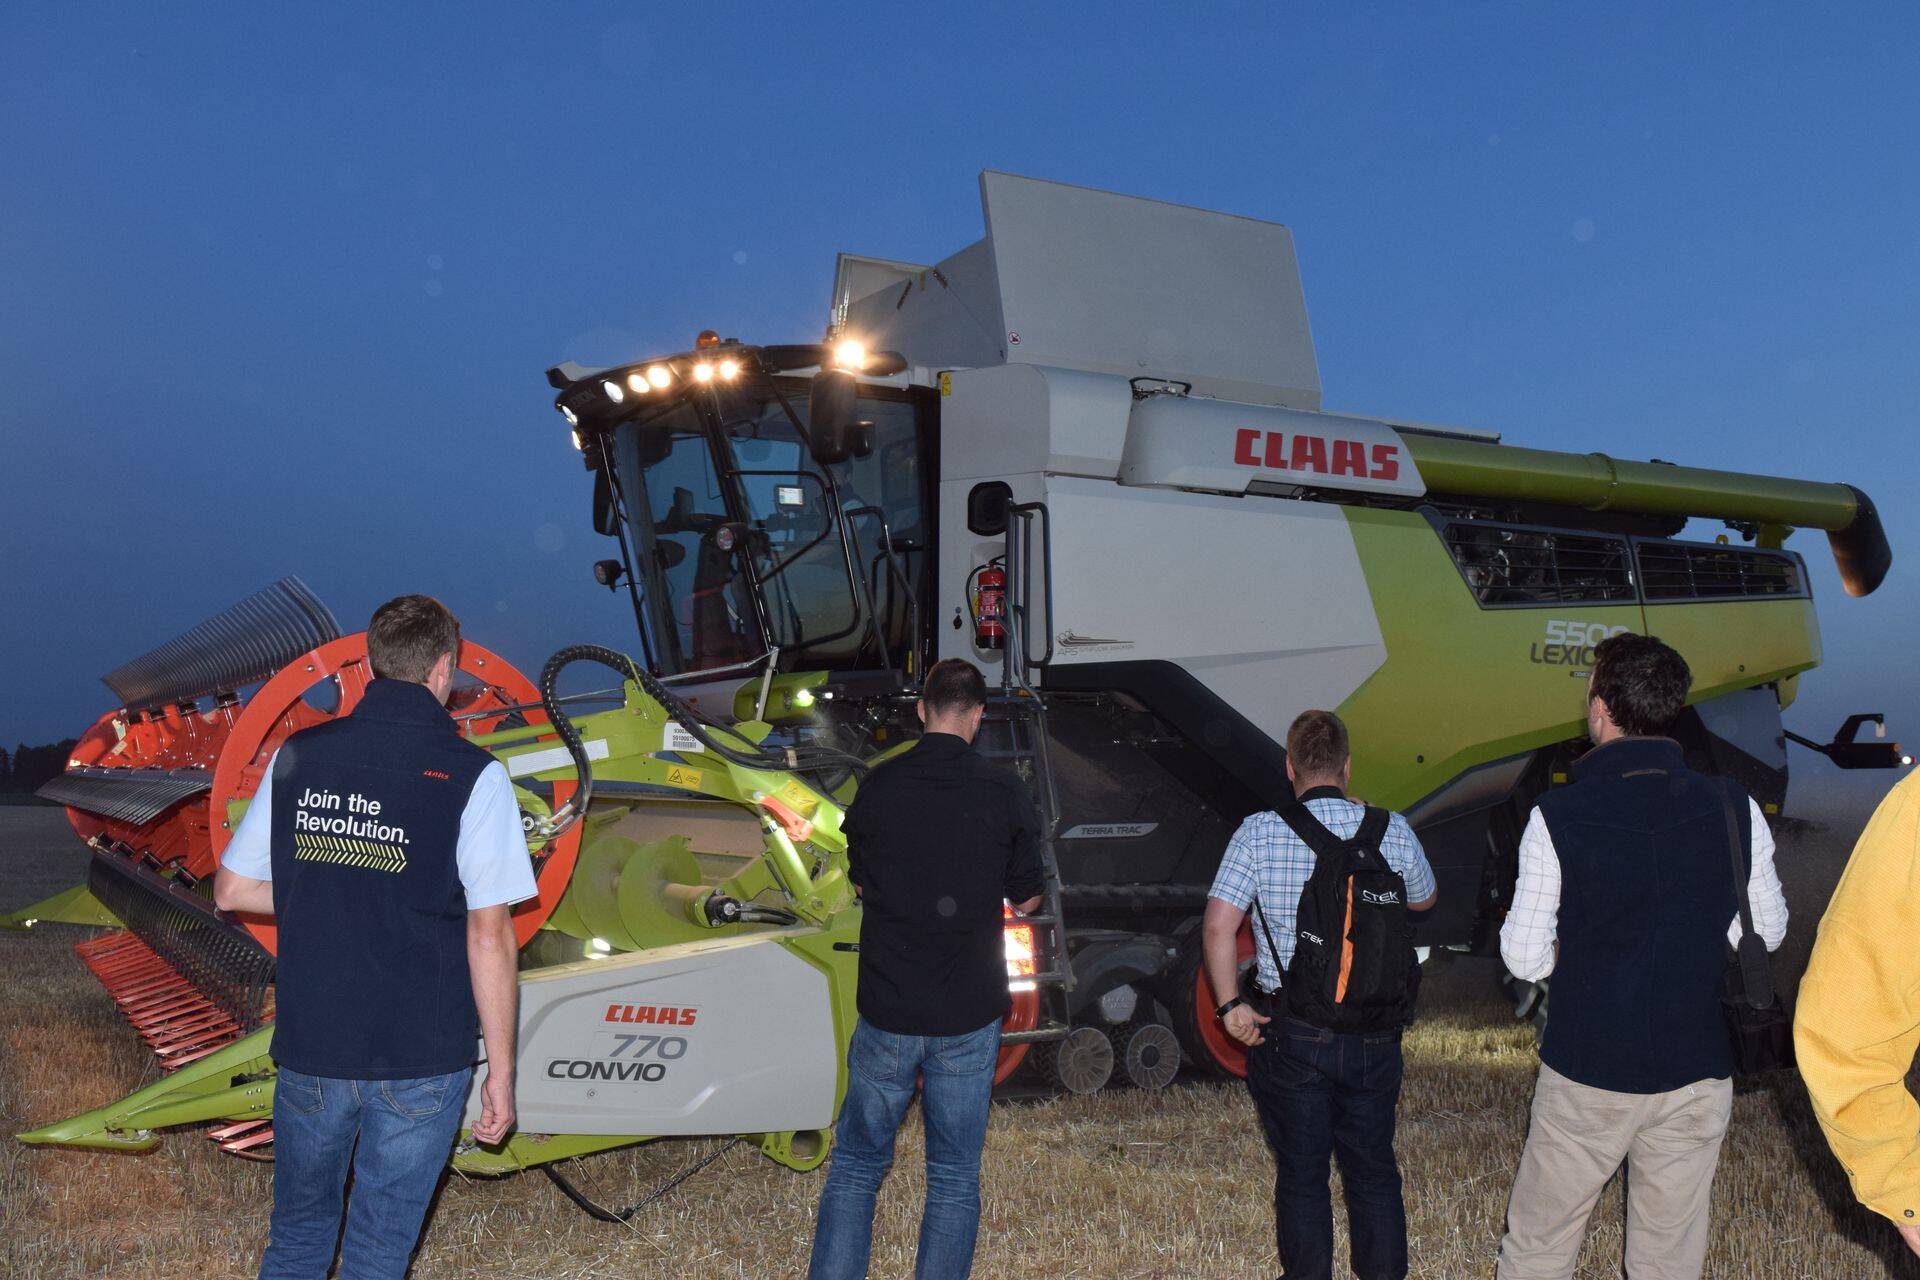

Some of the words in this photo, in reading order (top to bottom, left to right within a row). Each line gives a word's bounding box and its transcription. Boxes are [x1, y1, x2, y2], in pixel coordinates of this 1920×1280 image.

[1235, 428, 1399, 481] CLAAS
[298, 788, 340, 810] Join
[348, 794, 381, 815] the
[295, 810, 410, 844] Revolution.
[1081, 827, 1113, 835] TERRA
[1362, 890, 1399, 901] CTEK
[1301, 931, 1324, 946] CTEK
[605, 1005, 697, 1025] CLAAS
[609, 1034, 688, 1059] 770
[547, 1060, 666, 1082] CONVIO
